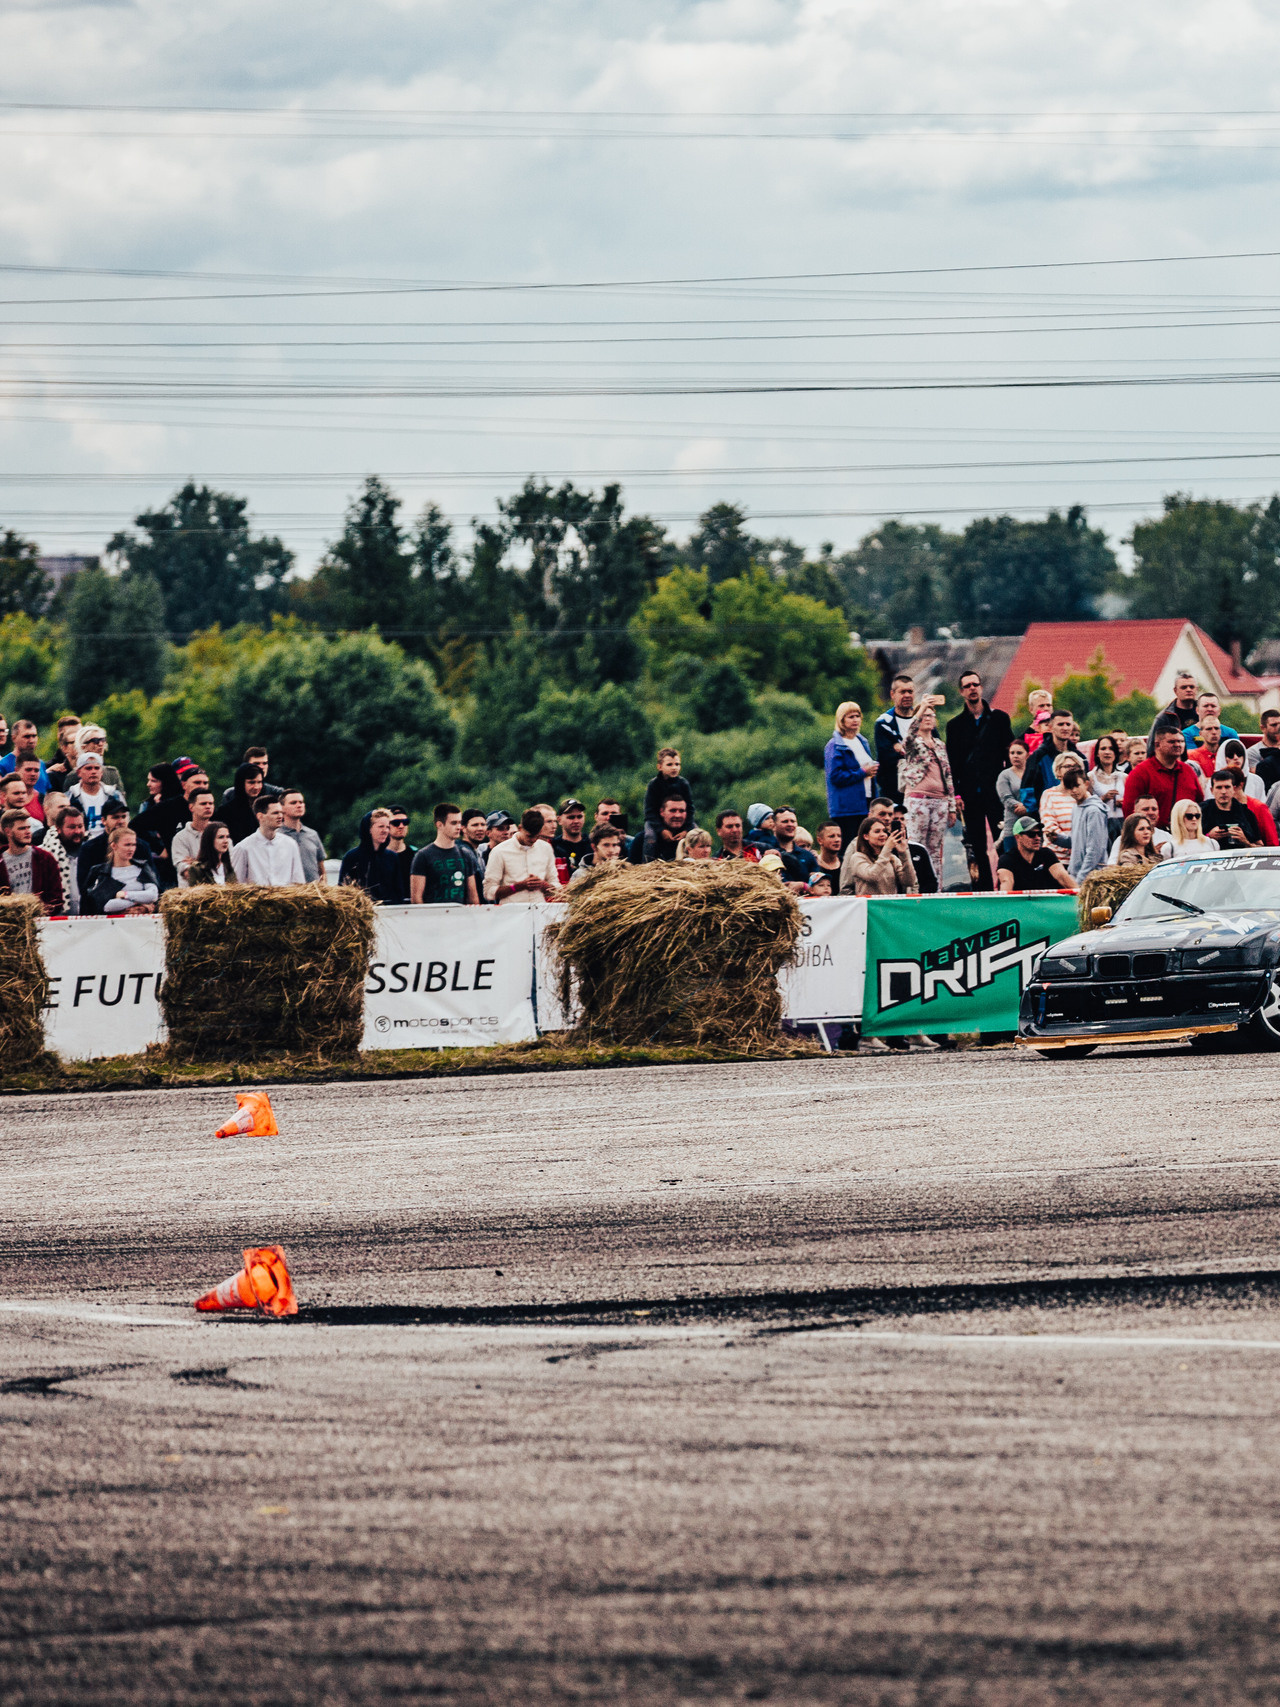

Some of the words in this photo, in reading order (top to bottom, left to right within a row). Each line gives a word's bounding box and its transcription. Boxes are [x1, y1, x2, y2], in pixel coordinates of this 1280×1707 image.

[923, 922, 1018, 971] Latvian
[880, 937, 1047, 1009] DRIFT
[393, 1016, 499, 1029] motosports
